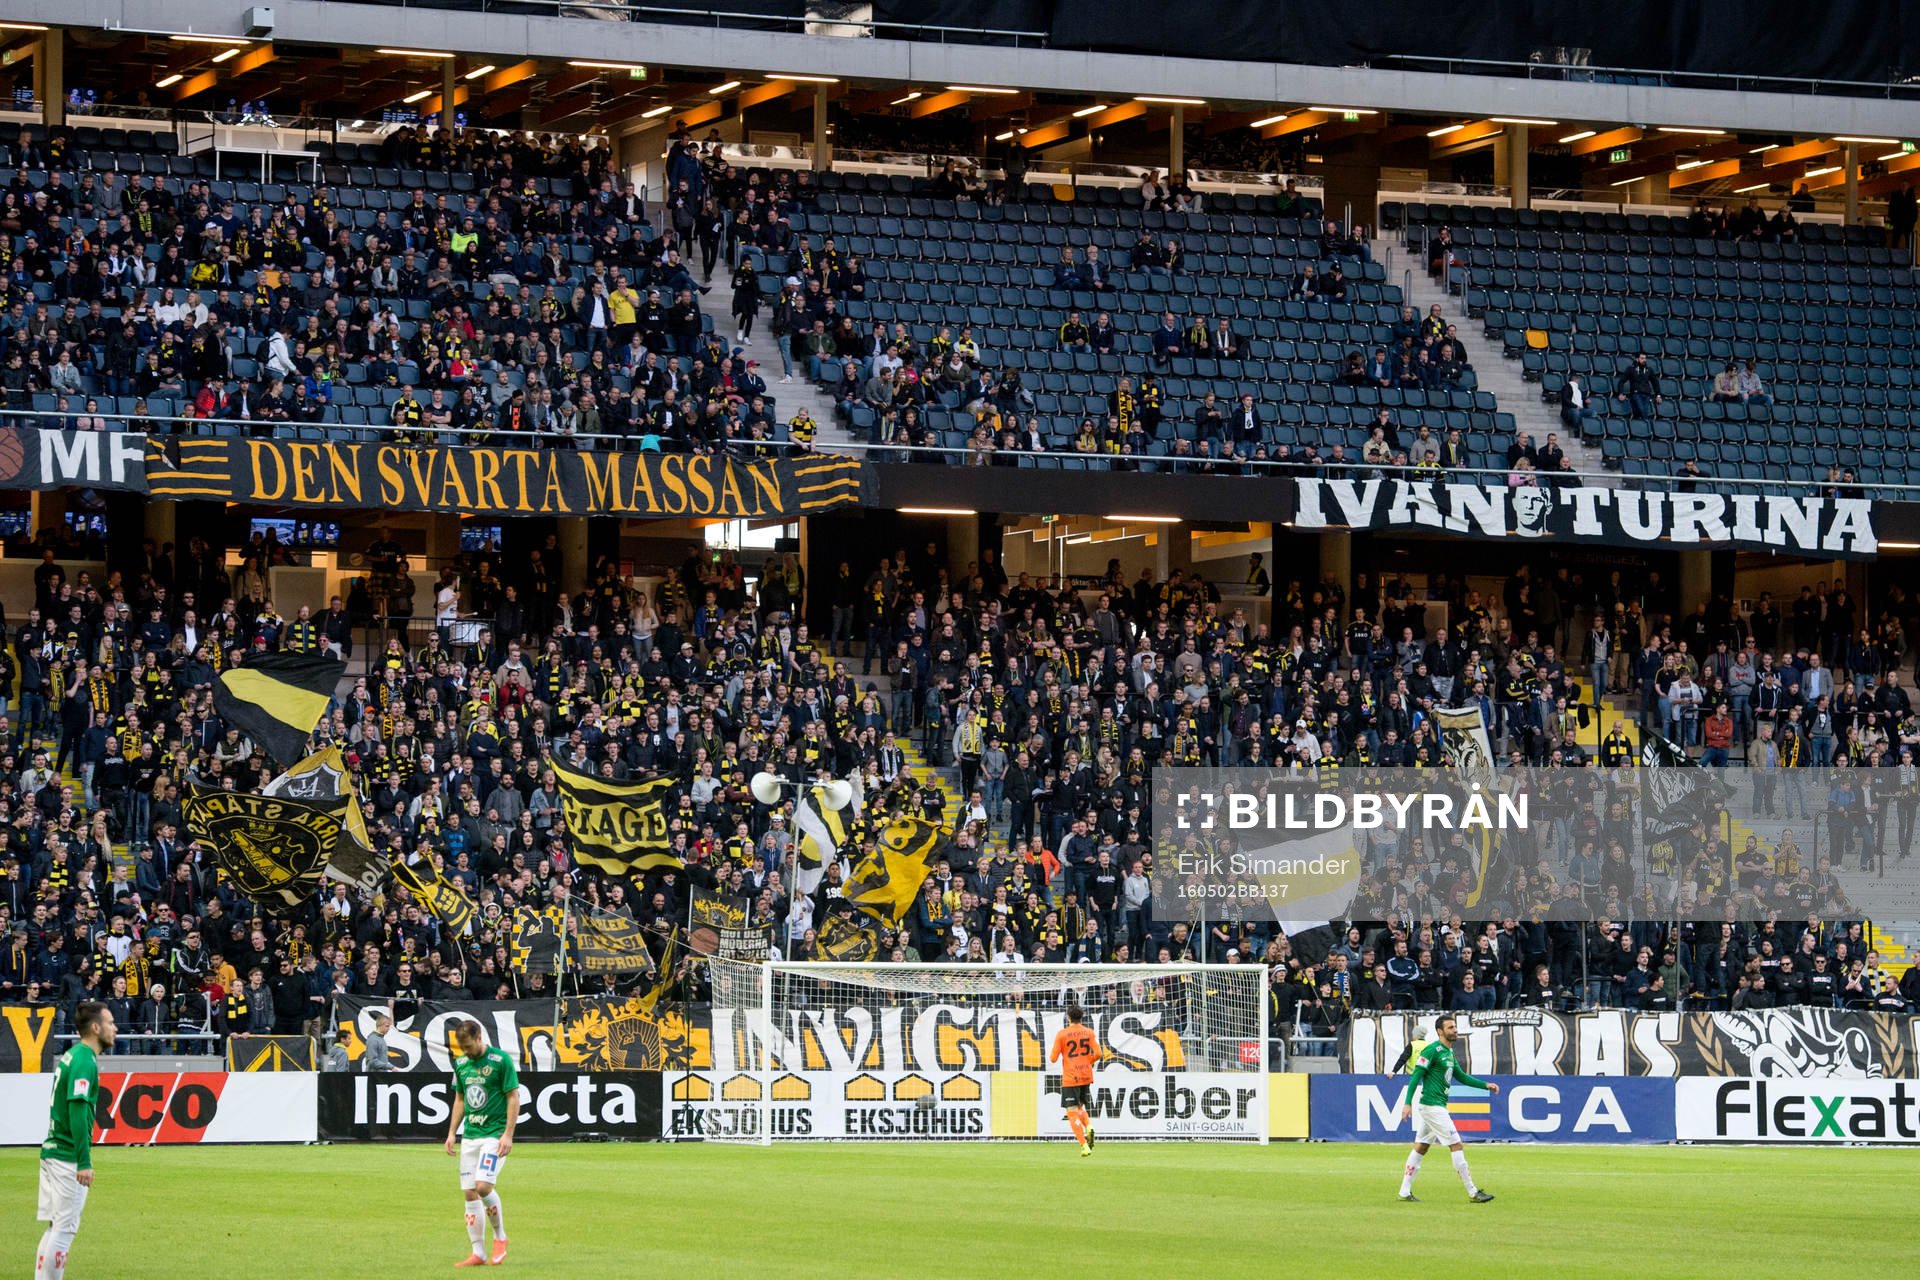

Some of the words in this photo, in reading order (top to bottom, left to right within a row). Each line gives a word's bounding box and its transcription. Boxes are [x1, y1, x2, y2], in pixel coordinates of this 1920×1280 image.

[246, 439, 362, 503] DEN
[376, 446, 572, 514] SVARTA
[577, 451, 784, 516] MASSAN
[1293, 477, 1509, 537] IVAN
[1559, 486, 1878, 553] TURINA
[2, 1006, 56, 1072] Y
[711, 1004, 1165, 1072] INVICTUS
[1471, 1009, 1541, 1020] YOUNGSTERS
[1066, 1037, 1090, 1058] 25
[1084, 1075, 1257, 1120] weber
[1166, 1121, 1245, 1132] SAINT-GOBAIN
[1716, 1080, 1920, 1138] Flexat
